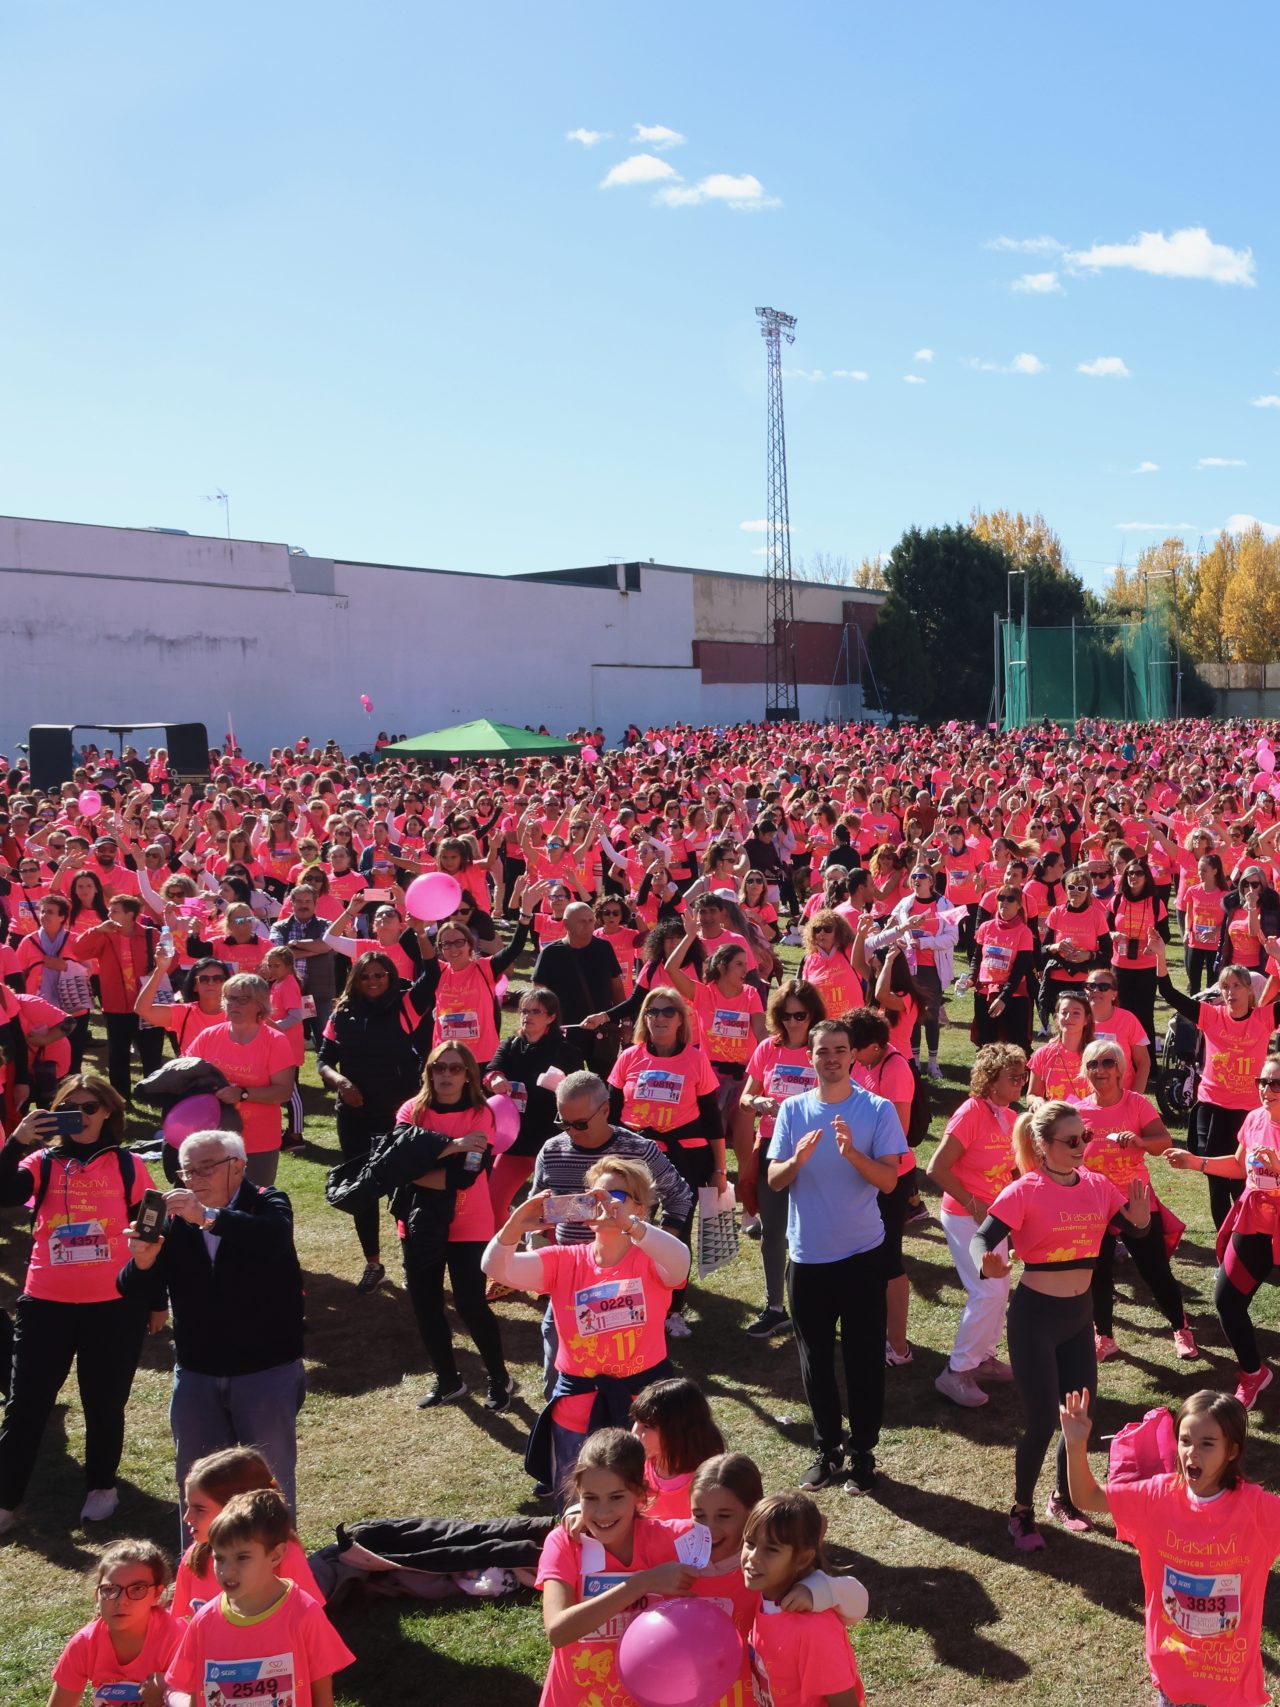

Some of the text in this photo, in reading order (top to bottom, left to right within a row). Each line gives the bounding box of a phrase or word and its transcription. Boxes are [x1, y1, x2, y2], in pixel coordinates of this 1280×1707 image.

[600, 1295, 634, 1312] 0226
[1187, 1596, 1226, 1612] 3833
[232, 1677, 279, 1698] 2549
